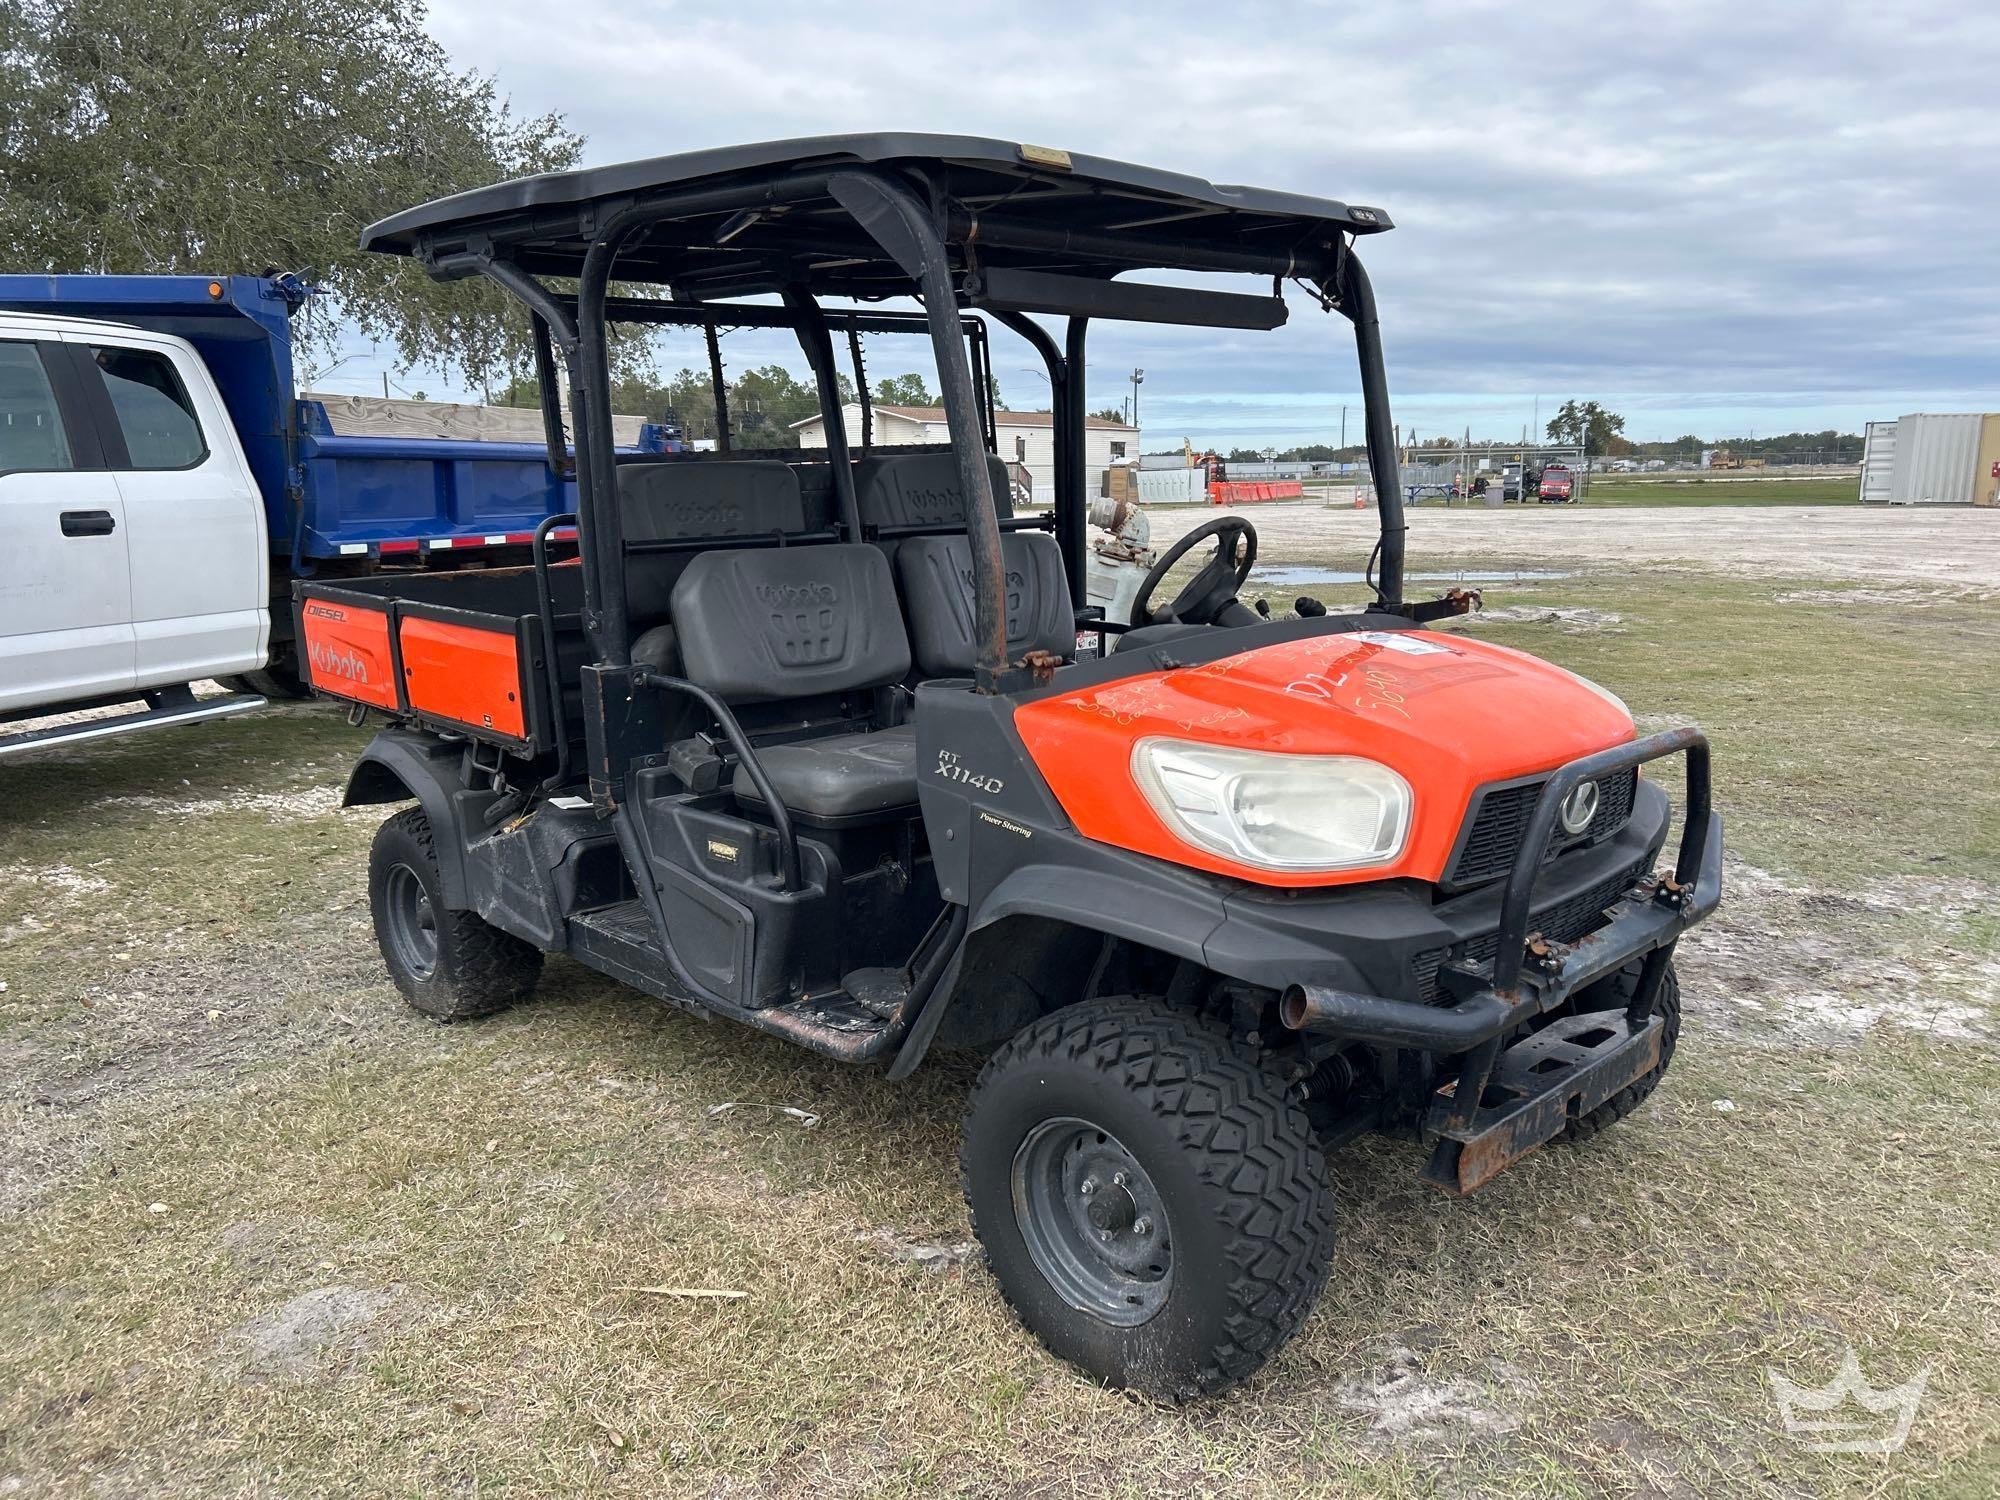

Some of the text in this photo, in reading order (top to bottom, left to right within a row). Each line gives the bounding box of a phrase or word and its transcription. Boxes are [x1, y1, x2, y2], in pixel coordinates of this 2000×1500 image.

[307, 605, 347, 622] DIESEL
[310, 640, 368, 684] Kubota
[939, 750, 961, 763] RT
[934, 761, 1004, 794] X1140
[979, 812, 1032, 839] Power Steering
